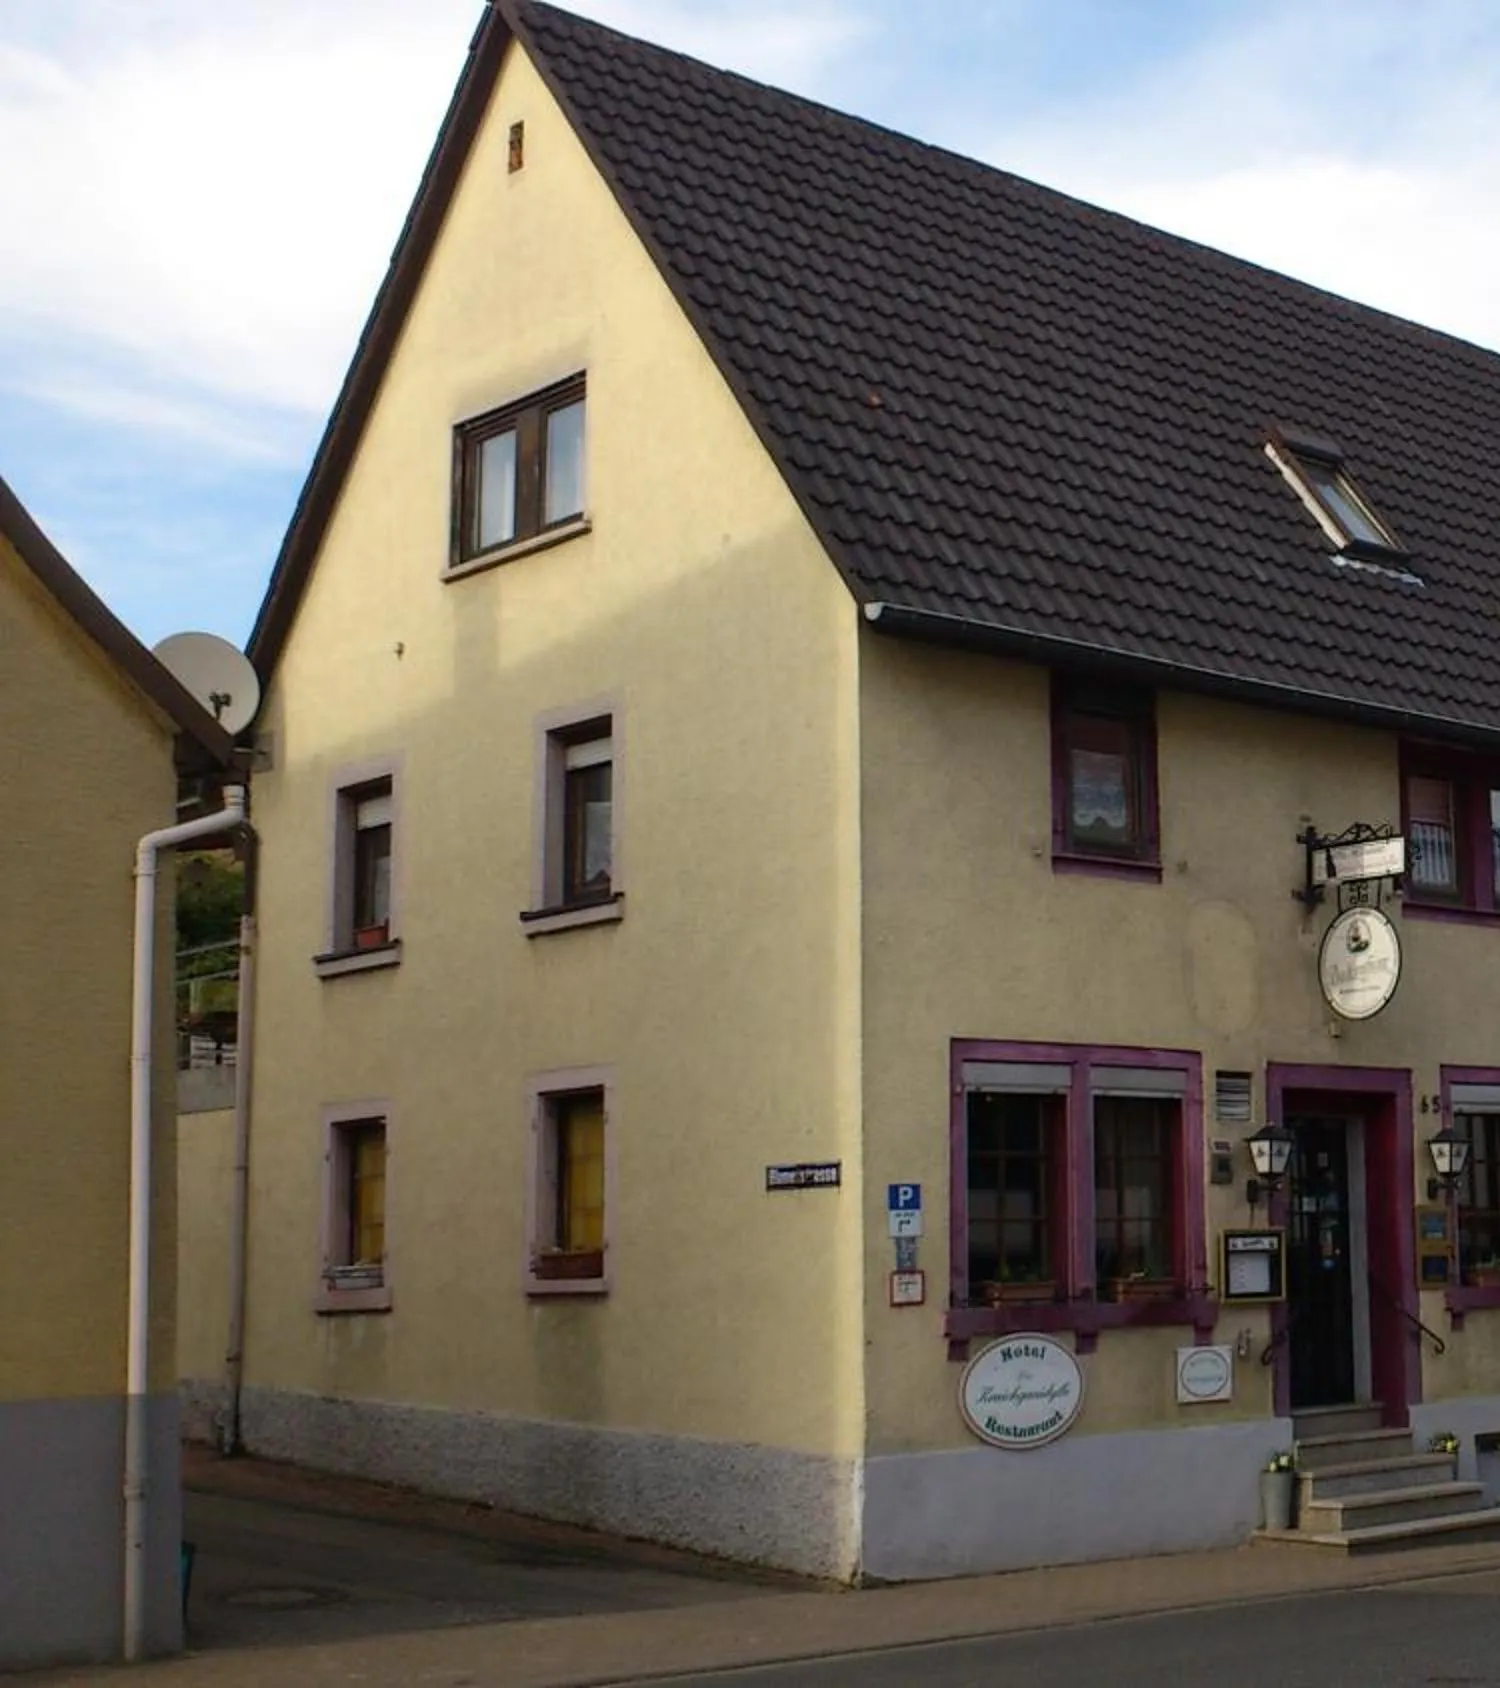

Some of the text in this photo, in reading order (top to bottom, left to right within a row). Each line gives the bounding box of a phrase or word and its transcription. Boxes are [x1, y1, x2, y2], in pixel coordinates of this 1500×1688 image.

[898, 1186, 914, 1208] P
[1000, 1344, 1047, 1362] Hotel
[984, 1411, 1064, 1438] Restaurant
